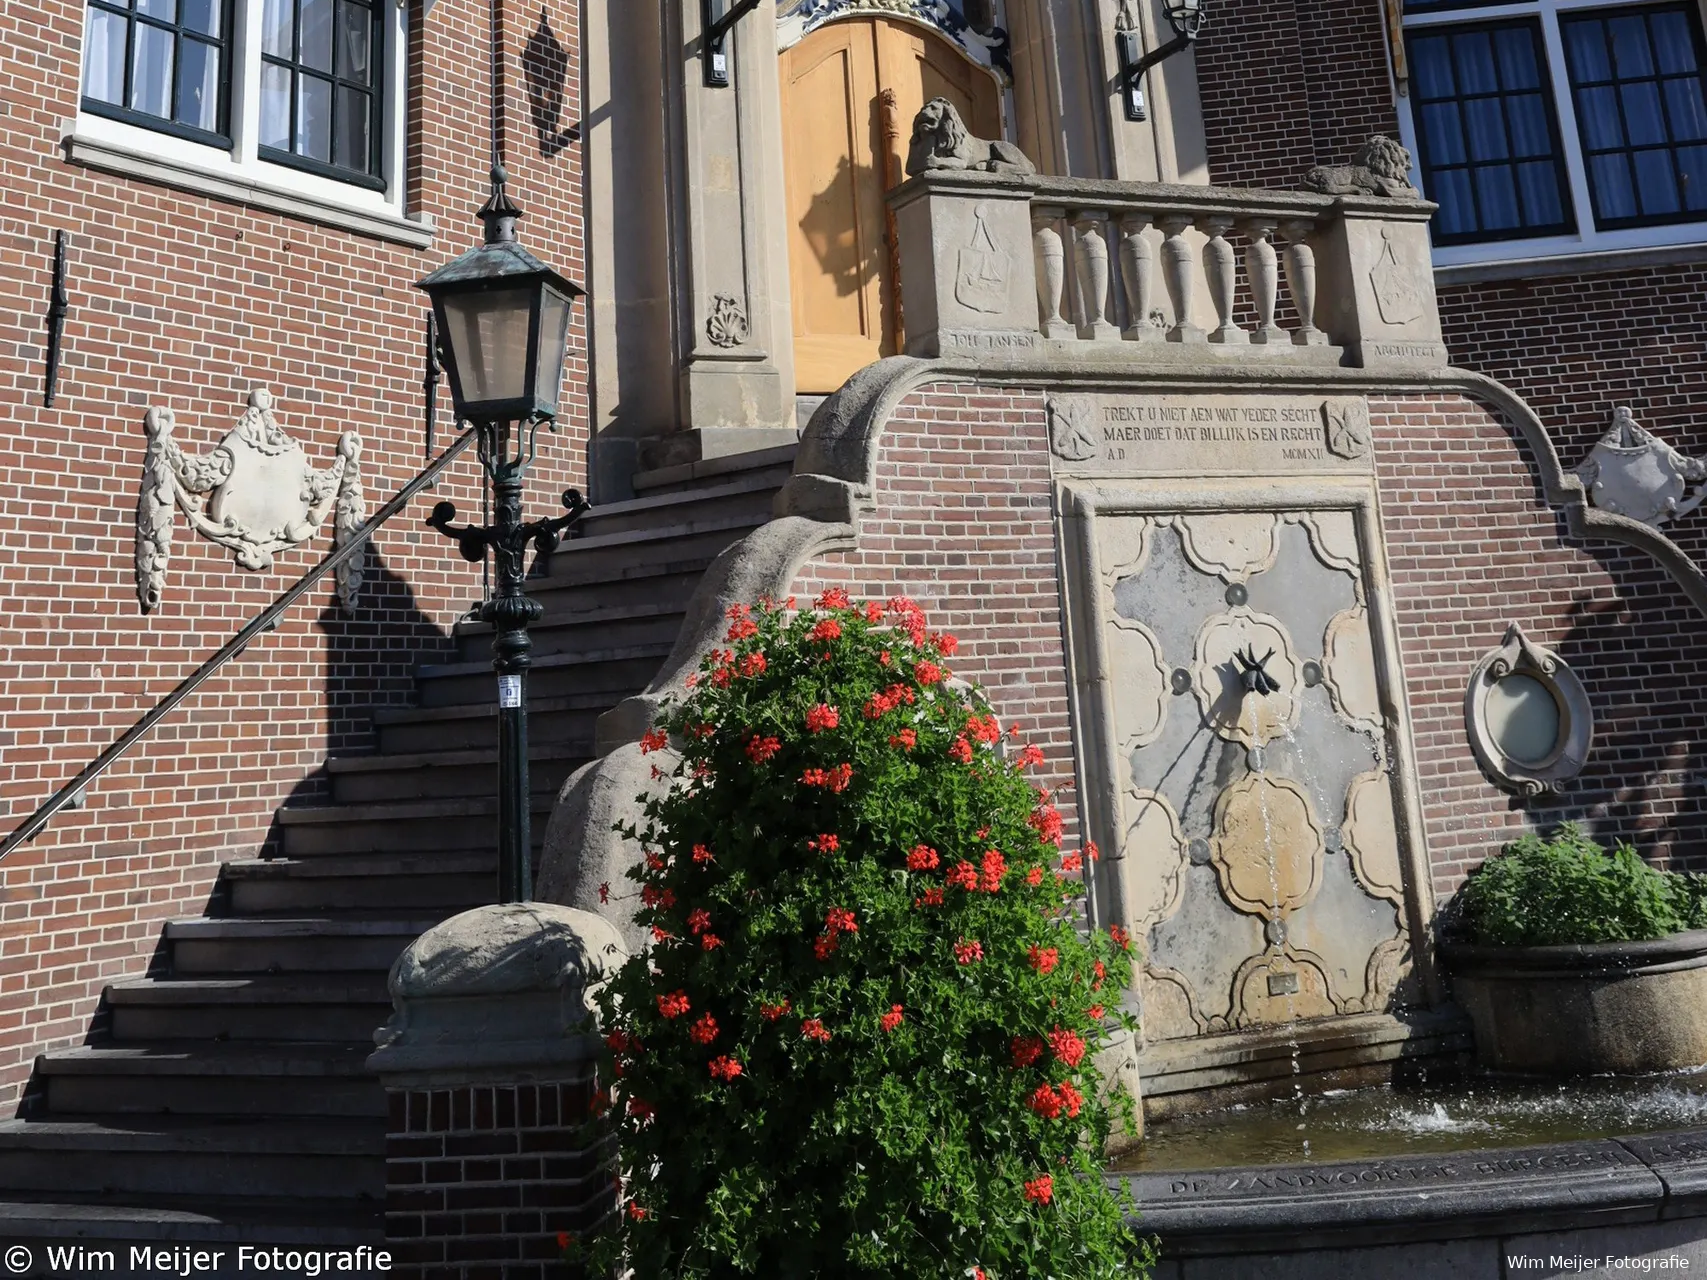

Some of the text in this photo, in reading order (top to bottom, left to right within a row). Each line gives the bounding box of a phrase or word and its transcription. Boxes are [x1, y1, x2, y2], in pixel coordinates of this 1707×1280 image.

[1375, 345, 1436, 358] ARCHITECT
[1102, 407, 1317, 422] TREKT U NIET AEN WAT YEDER SECHT
[1103, 427, 1142, 441] MAER
[1144, 427, 1171, 441] DOET
[1175, 427, 1197, 441] DAT
[1247, 427, 1259, 441] IS
[1261, 427, 1278, 441] EN
[1281, 427, 1322, 441] RECHT
